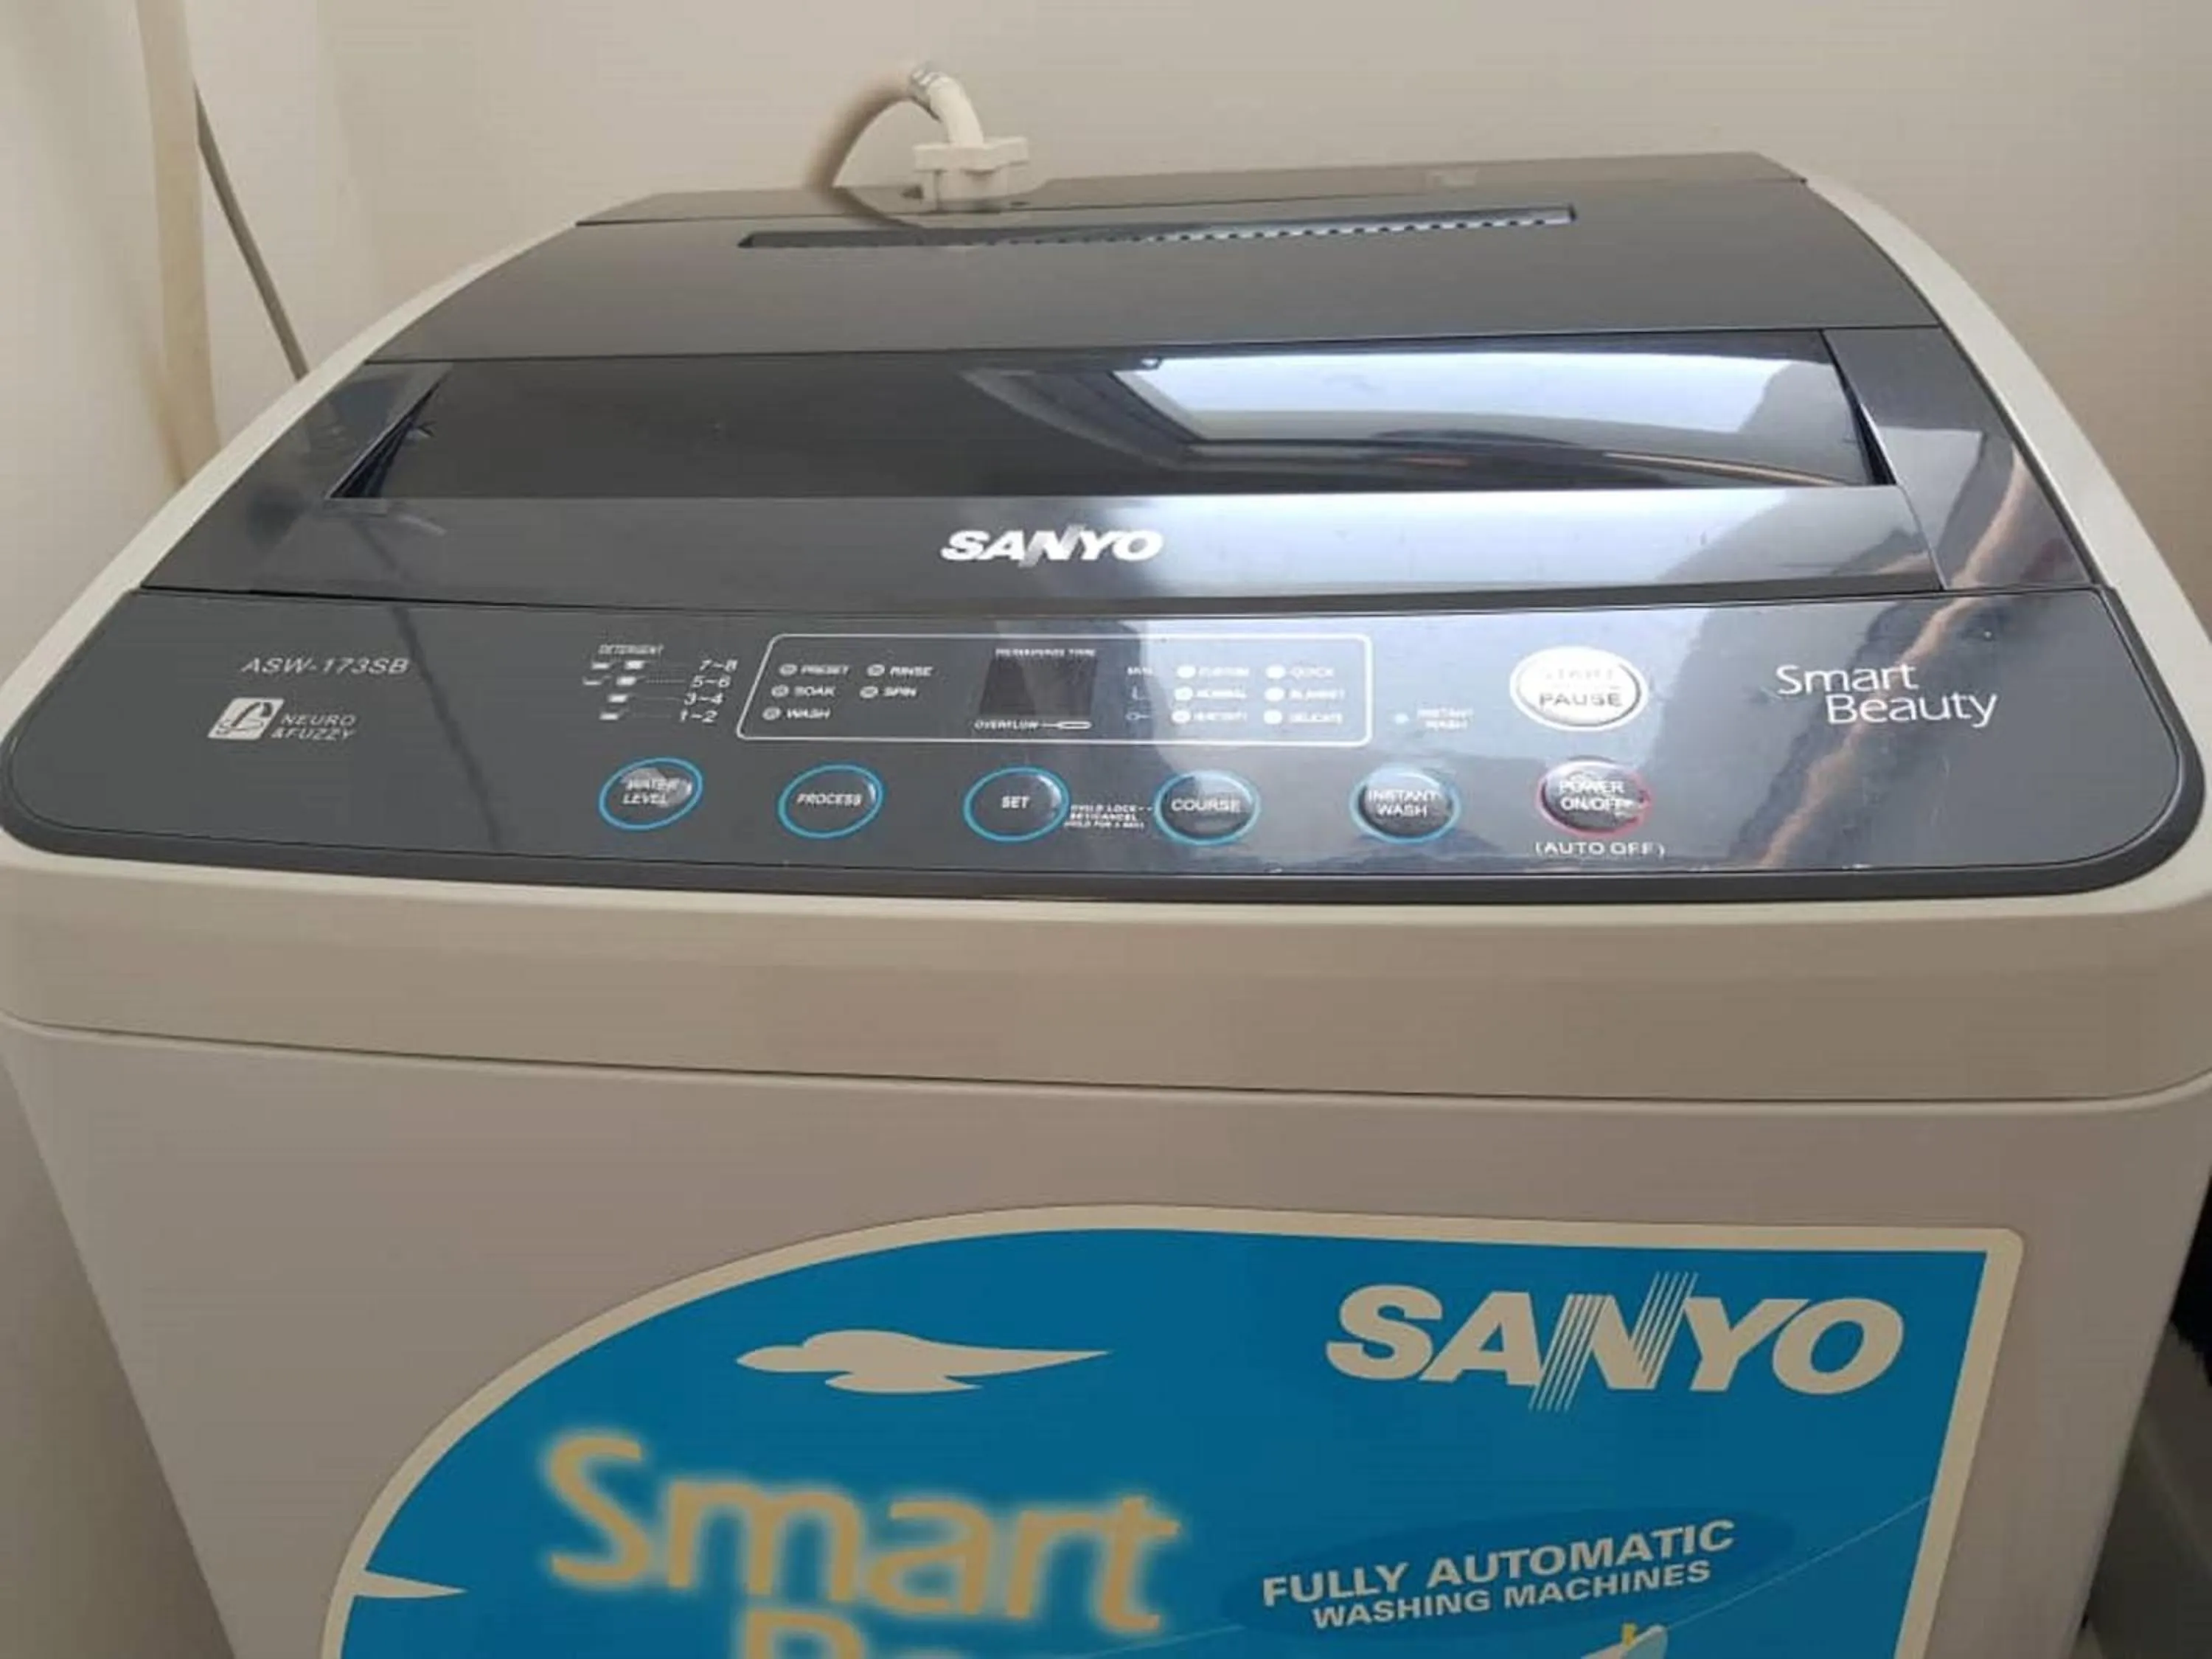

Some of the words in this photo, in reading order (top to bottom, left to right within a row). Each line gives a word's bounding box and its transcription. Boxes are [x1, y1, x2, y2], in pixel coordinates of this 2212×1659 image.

[940, 524, 1164, 567] SANYO
[240, 657, 409, 675] ASW-173SB
[1775, 663, 1919, 695] Smart
[1539, 692, 1623, 707] PAUSE
[786, 707, 831, 720] WASH
[1825, 692, 1997, 728] Beauty
[280, 713, 356, 727] NEURO
[1559, 780, 1625, 795] POWER
[622, 793, 669, 805] LEVEL
[796, 793, 863, 806] PROCESS
[1001, 796, 1029, 809] SET
[1368, 789, 1440, 804] INSTANT
[1171, 798, 1241, 813] COURSE
[1377, 802, 1427, 818] WASH
[1536, 841, 1605, 856] (AUTO
[1326, 1272, 1905, 1410] SANYO
[542, 1429, 1183, 1637] Smart
[1262, 1562, 1408, 1607] FULLY
[1426, 1519, 1736, 1590] AUTOMATIC
[1312, 1589, 1491, 1630] WASHING
[1503, 1560, 1711, 1610] MACHINES
